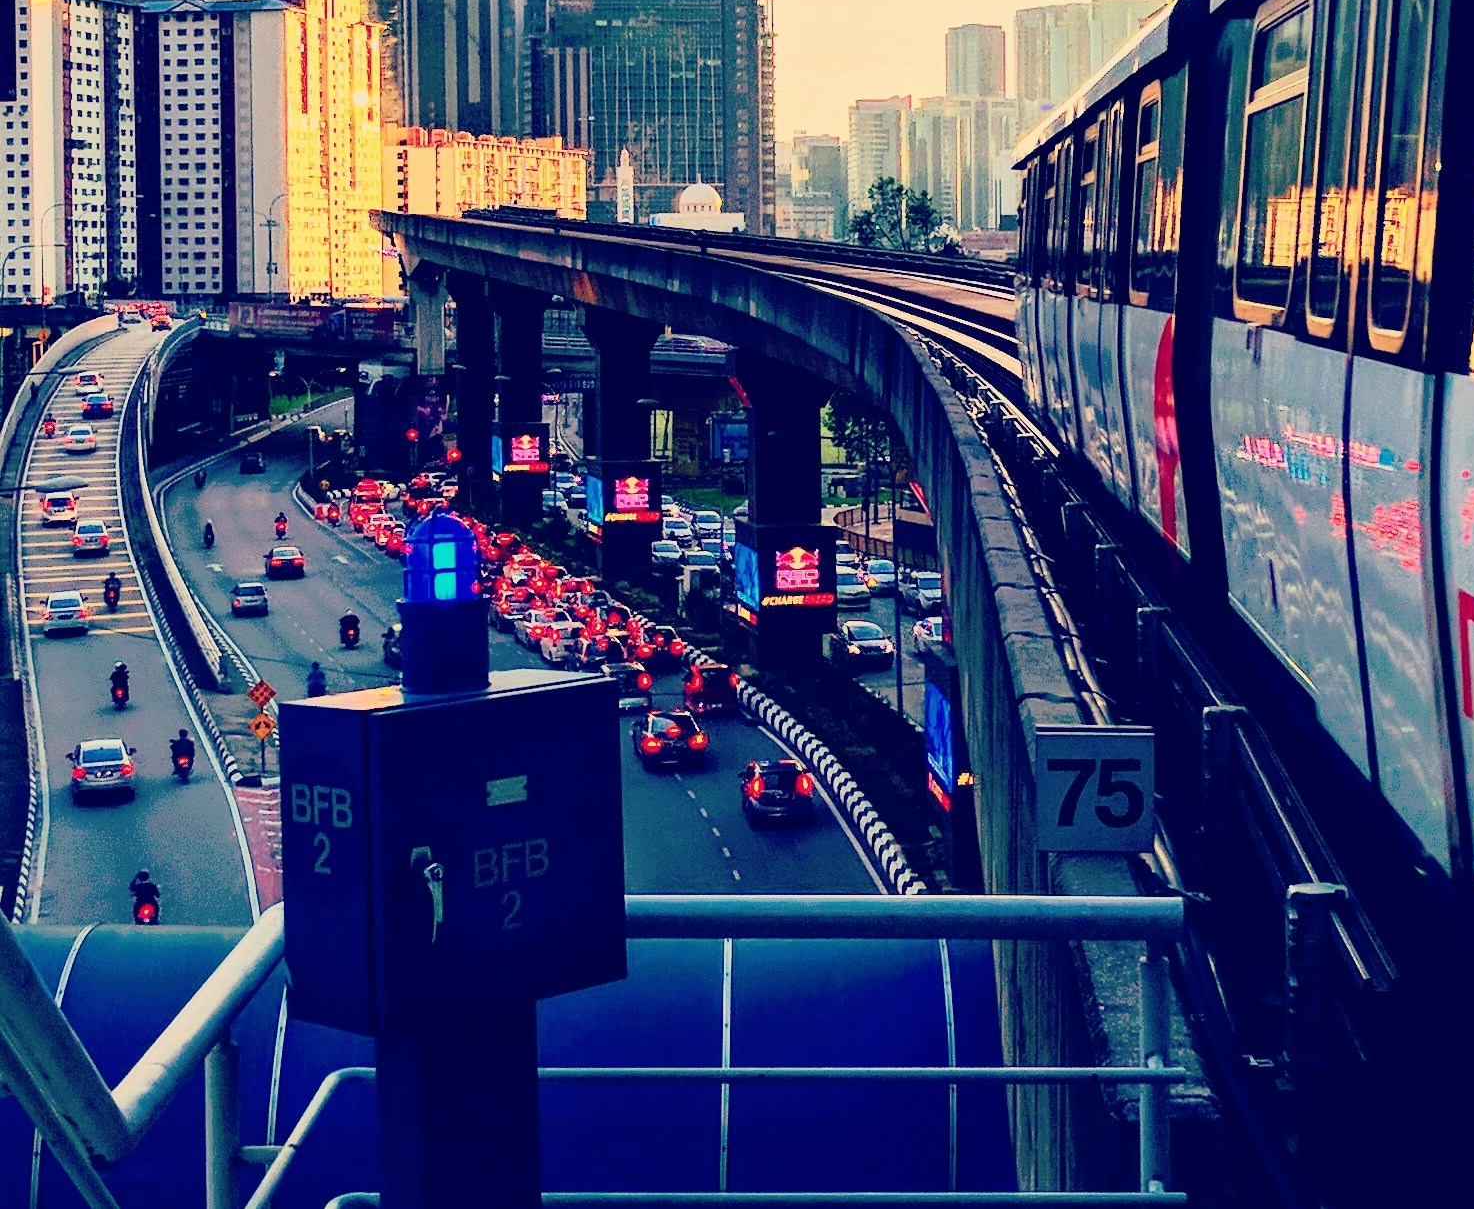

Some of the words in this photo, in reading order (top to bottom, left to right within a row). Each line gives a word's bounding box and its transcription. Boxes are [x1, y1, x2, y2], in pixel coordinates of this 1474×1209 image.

[291, 783, 353, 828] BFB
[1047, 758, 1145, 829] 75
[313, 832, 332, 875] 2
[474, 838, 549, 888] BFB
[501, 890, 522, 930] 2
